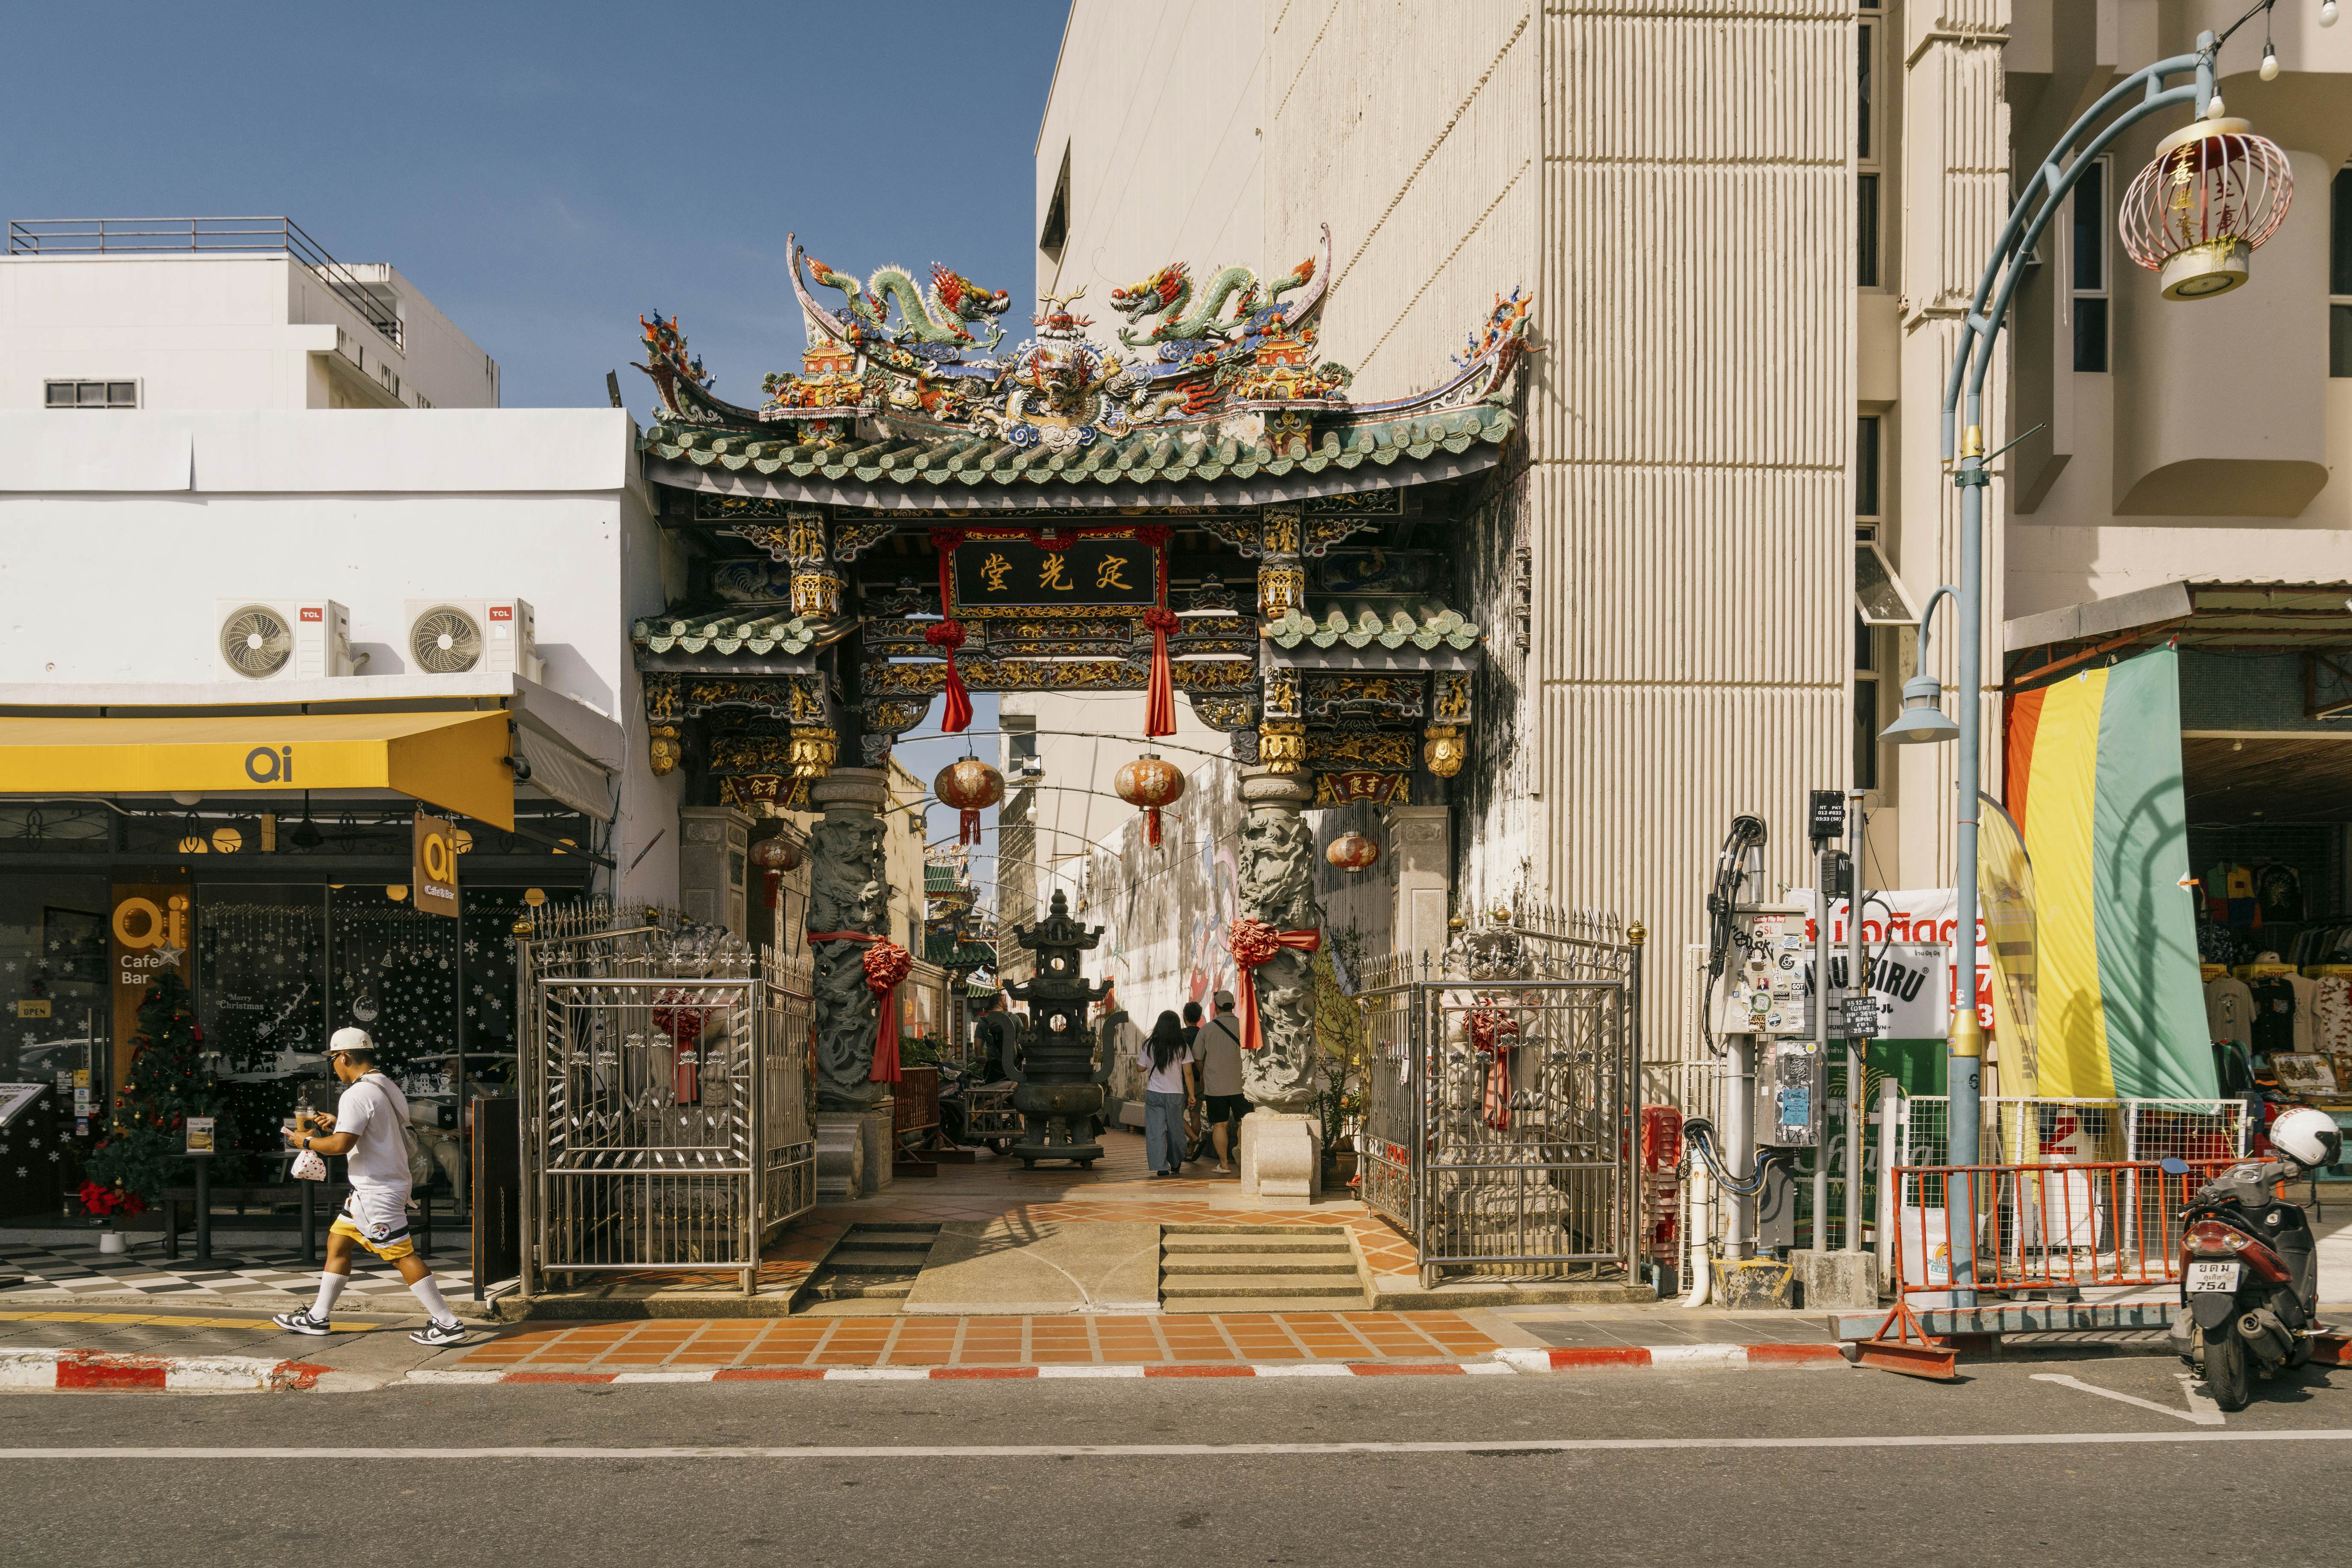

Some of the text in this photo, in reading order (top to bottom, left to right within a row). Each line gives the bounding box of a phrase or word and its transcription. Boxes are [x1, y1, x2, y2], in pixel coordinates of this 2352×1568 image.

[245, 745, 292, 783] Qi
[423, 833, 454, 884] Qi
[1839, 859, 1849, 871] NT
[425, 885, 454, 900] Cafe & Bar
[112, 896, 182, 948] Qi
[121, 955, 159, 967] Cafe
[122, 972, 150, 984] Bar
[228, 993, 251, 1001] Merry
[216, 1000, 264, 1010] Christmas
[2196, 1282, 2226, 1290] 754
